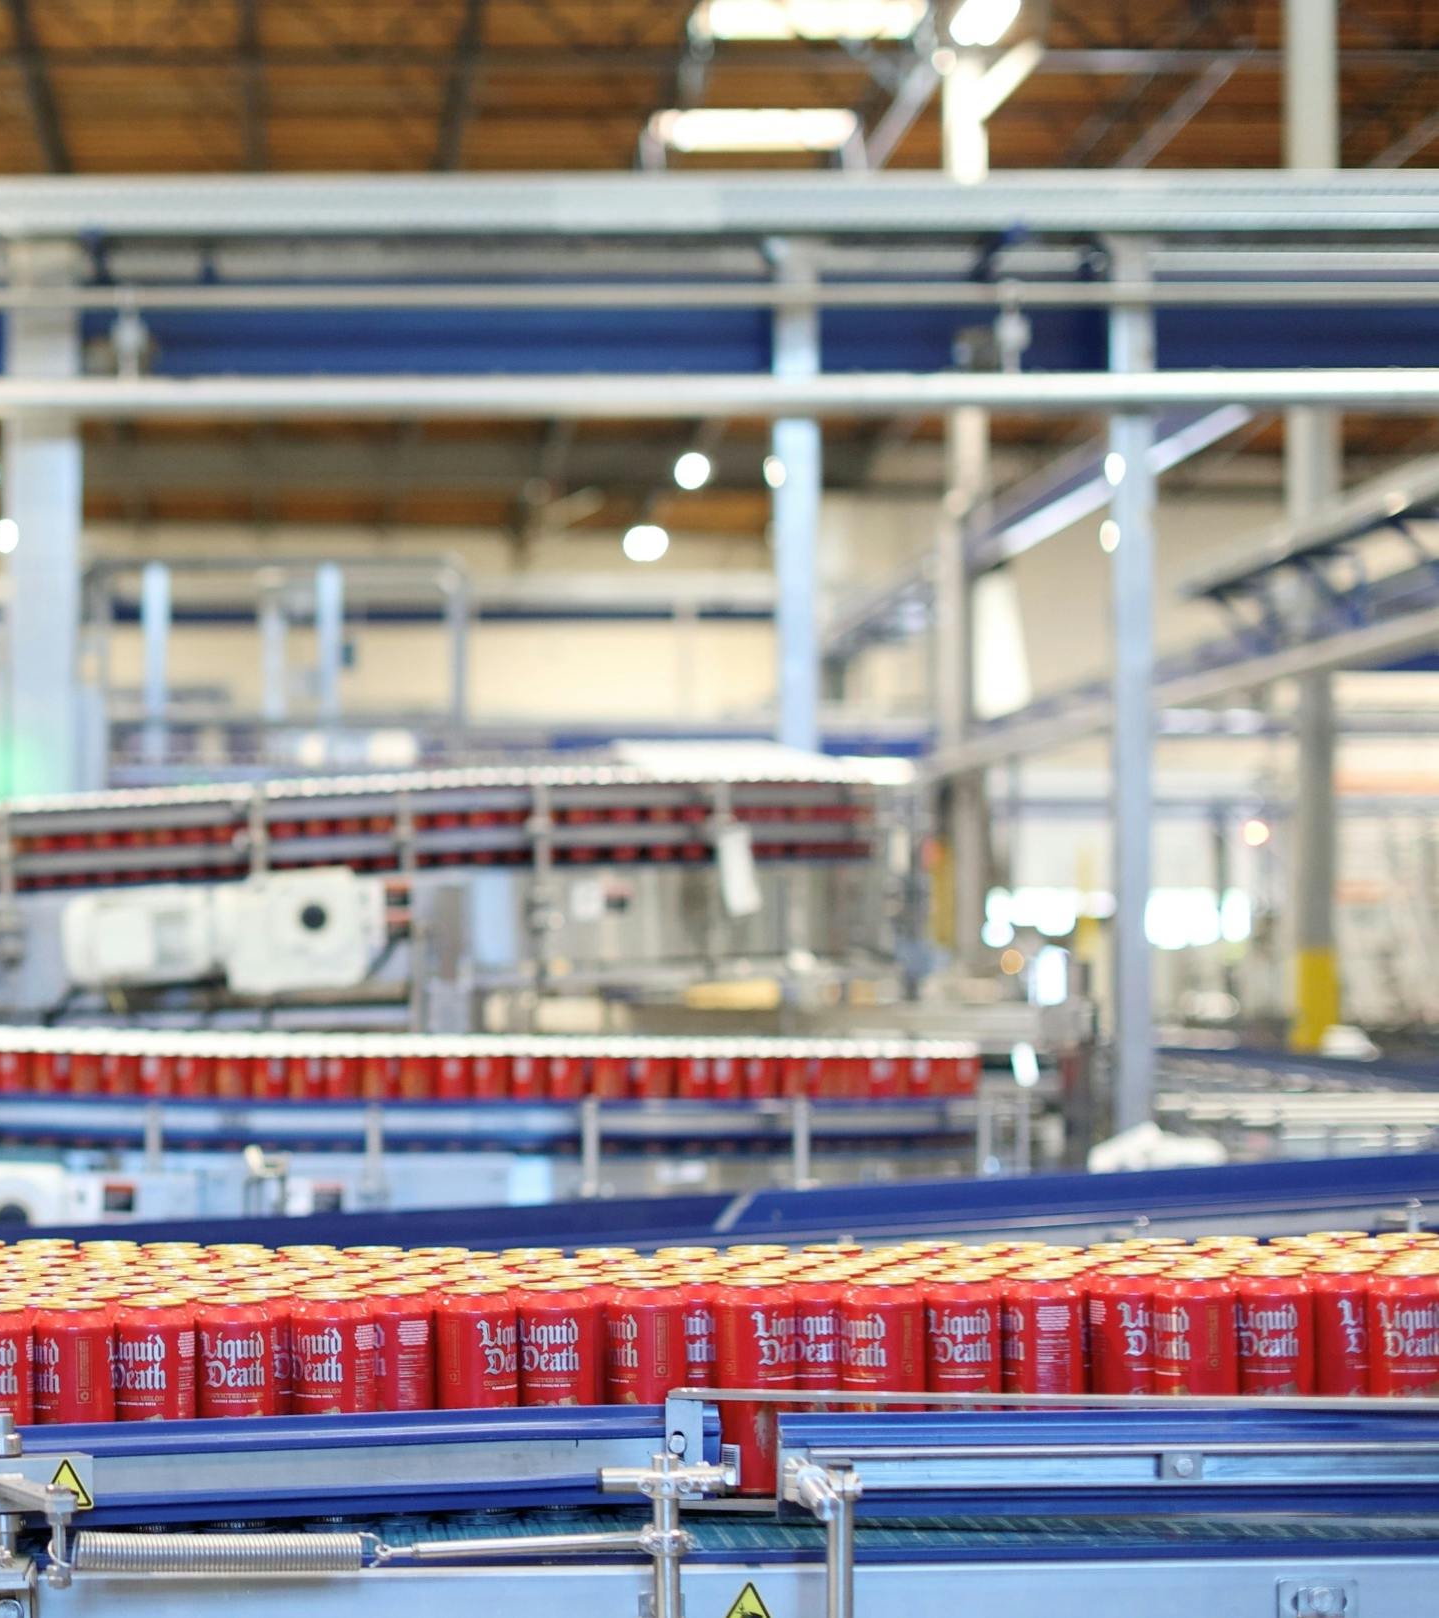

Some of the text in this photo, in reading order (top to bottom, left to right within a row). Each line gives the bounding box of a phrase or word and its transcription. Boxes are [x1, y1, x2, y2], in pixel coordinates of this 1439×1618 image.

[519, 1317, 579, 1353] Liquid
[842, 1313, 886, 1347] quid
[927, 1307, 991, 1343] Liquid
[1233, 1303, 1298, 1338] Liquid
[106, 1334, 165, 1369] Liquid
[200, 1330, 264, 1367] Liquid
[521, 1345, 579, 1372] Death
[932, 1335, 992, 1363] Death
[1235, 1330, 1299, 1358] Death
[111, 1362, 167, 1390] Death
[205, 1359, 265, 1388] Death
